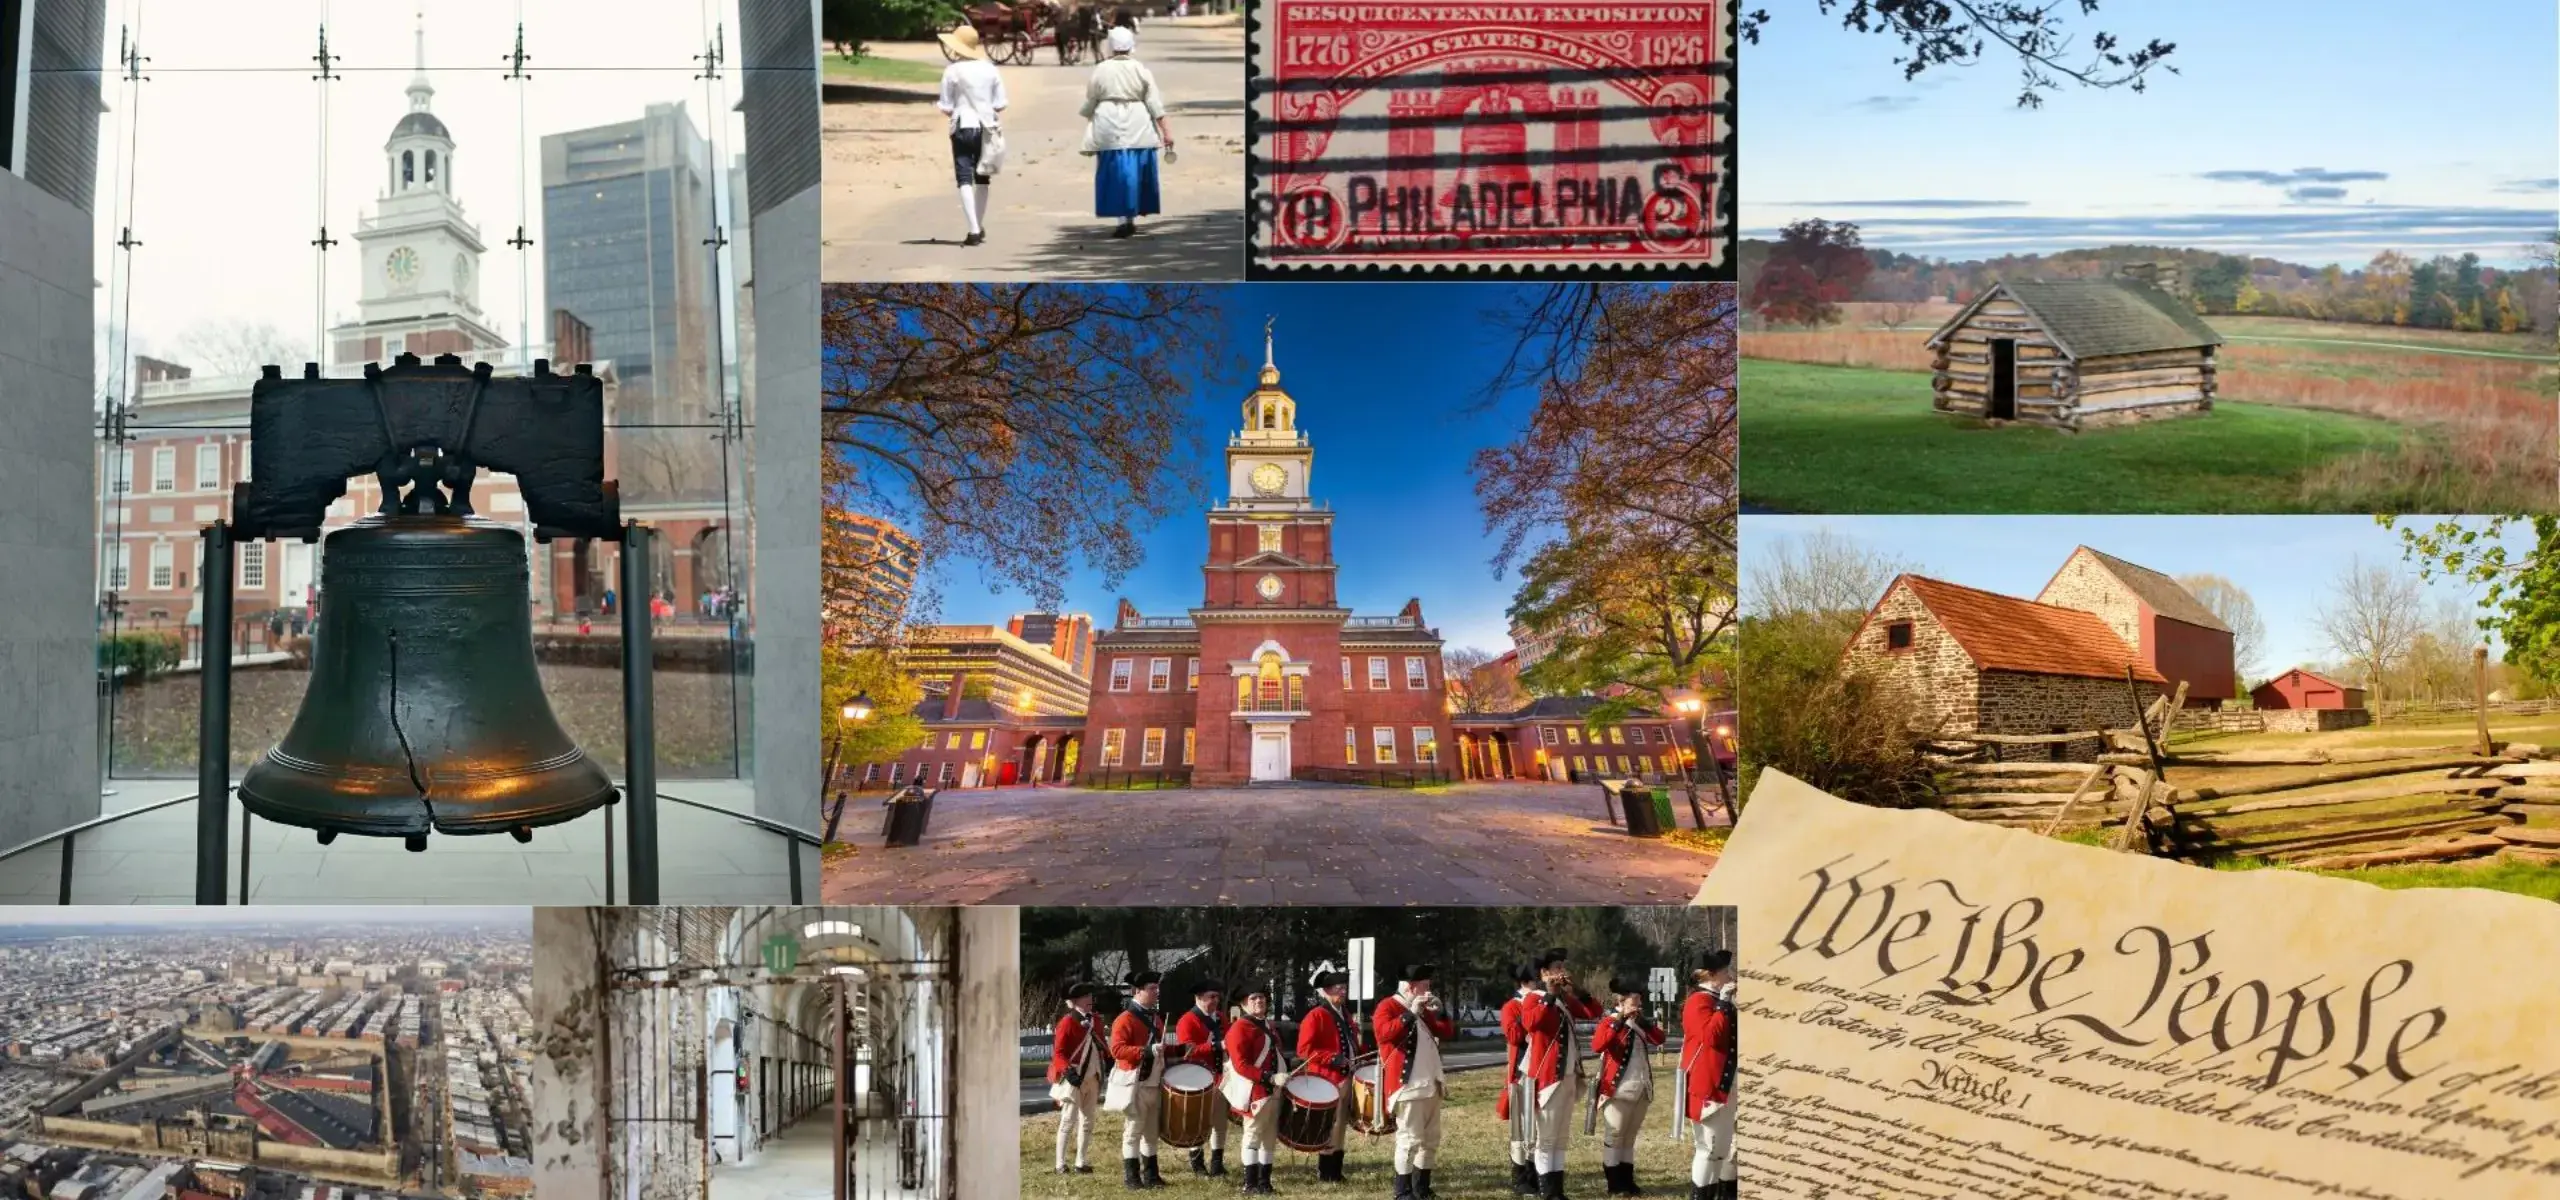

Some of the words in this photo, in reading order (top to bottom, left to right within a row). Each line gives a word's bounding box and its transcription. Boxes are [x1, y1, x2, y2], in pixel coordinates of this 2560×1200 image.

[1287, 6, 1539, 22] SESQUICENTENNIAL
[1544, 7, 1704, 22] EXPOSITION
[1284, 34, 1351, 66] 1776
[1336, 42, 1430, 95] ITED
[1432, 32, 1537, 52] STATES
[1540, 38, 1658, 98] POSTE
[1639, 34, 1704, 66] 1926
[1348, 175, 1644, 237] PHILADELPHIA
[1769, 853, 1940, 989] We
[2036, 925, 2449, 1099] People
[1793, 976, 1907, 1011] domestic
[2060, 1047, 2188, 1077] provide
[2163, 1060, 2235, 1088] for
[2276, 1087, 2403, 1115] common
[1901, 1059, 2014, 1106] Article
[1955, 1050, 2047, 1078] ordain
[2049, 1076, 2124, 1096] and
[2108, 1083, 2252, 1122] establish
[2235, 1103, 2299, 1131] this
